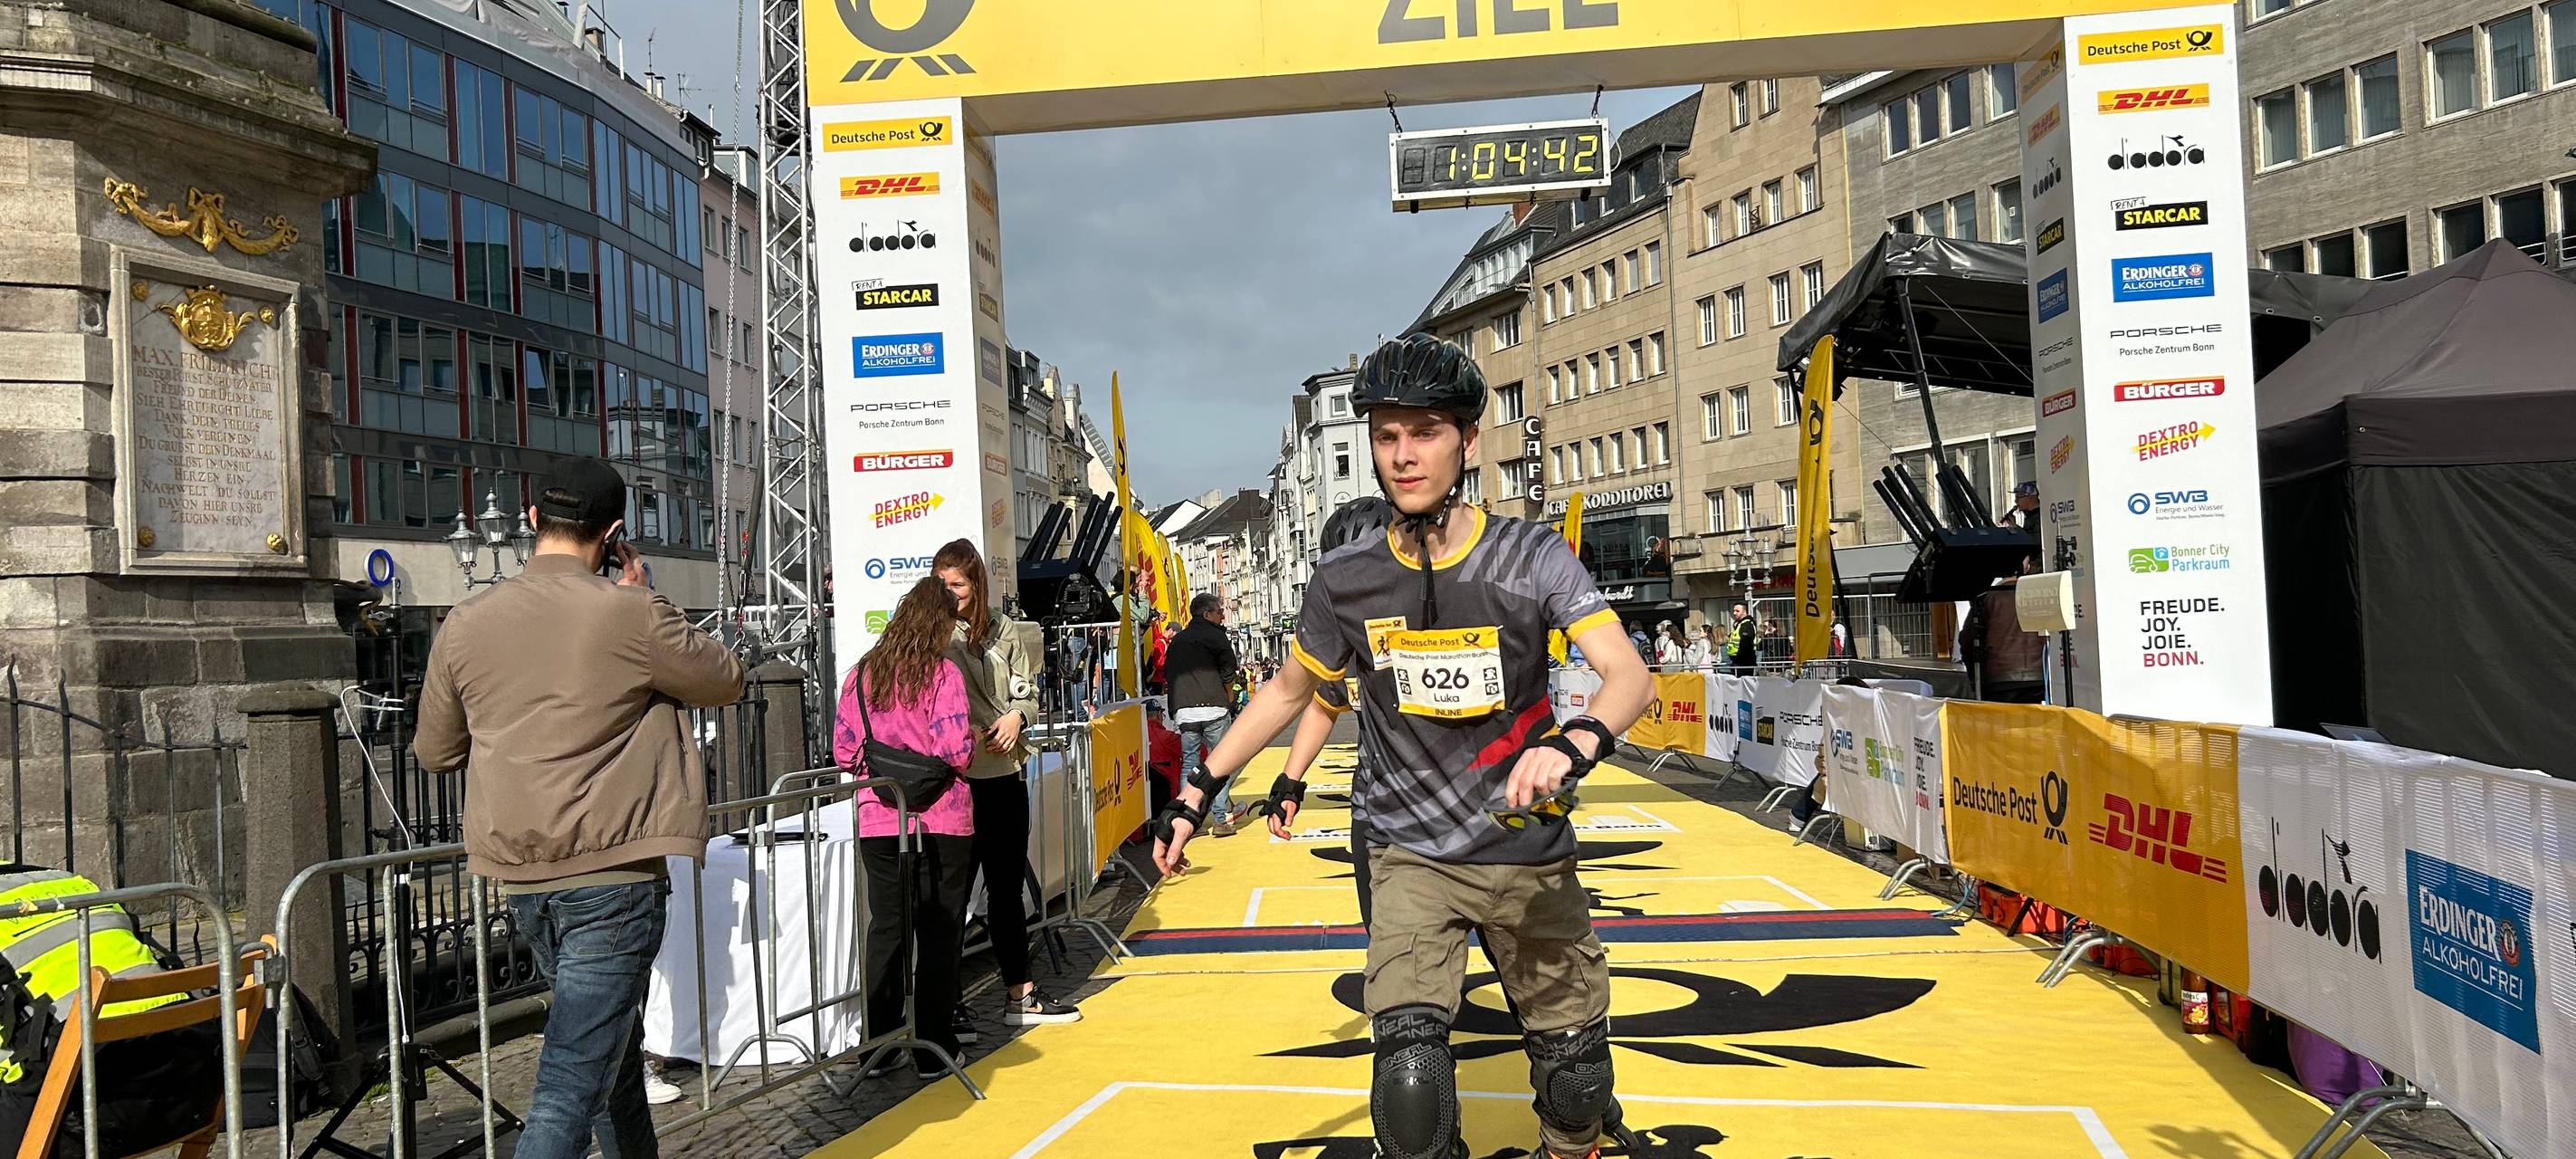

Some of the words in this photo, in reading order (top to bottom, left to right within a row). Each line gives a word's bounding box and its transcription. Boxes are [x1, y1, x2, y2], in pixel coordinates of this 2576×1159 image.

[2087, 41, 2148, 57] Deutsche
[2151, 39, 2181, 52] Post
[2113, 89, 2194, 110] DHL
[831, 131, 886, 145] Deutsche
[889, 129, 915, 140] Post
[1448, 135, 1598, 181] 1:04:42
[2107, 135, 2205, 170] diadora
[854, 177, 928, 196] DHL
[2123, 206, 2201, 225] STARCAR
[849, 220, 936, 253] diadora
[2122, 264, 2188, 281] ERDINGER
[2123, 279, 2205, 290] ALKOHOLFREI
[863, 289, 932, 305] STARCAR
[2110, 324, 2222, 339] PORSCHE
[862, 344, 921, 357] ERDINGER
[2119, 346, 2153, 356] Porsche
[2154, 344, 2190, 354] Zentrum
[2193, 342, 2215, 351] Bonn
[862, 356, 936, 367] ALKOHOLFREI
[199, 388, 217, 399] DER
[2123, 382, 2215, 399] BÜRGER
[851, 399, 950, 412] PORSCHE
[859, 420, 890, 429] Porsche
[891, 418, 923, 427] Zentrum
[925, 417, 945, 426] Bonn
[2138, 421, 2199, 447] DEXTRO
[139, 436, 155, 449] DU
[2139, 435, 2199, 461] ENERGY
[862, 454, 945, 470] BÜRGER
[1525, 418, 1542, 501] CAFE
[227, 474, 246, 484] EIN
[142, 479, 207, 497] NACHWELT
[218, 487, 233, 498] DU
[238, 489, 277, 501] SOLLST
[2155, 490, 2208, 504] SWB
[204, 500, 226, 512] HIER
[875, 491, 930, 515] DEXTRO
[1549, 499, 1570, 515] CAF
[1583, 483, 1669, 510] KONDITOREI
[875, 503, 930, 529] ENERGY
[2155, 506, 2181, 514] Energie
[2171, 546, 2207, 557] Bonner
[2209, 544, 2229, 557] City
[2172, 559, 2229, 571] Parkraum
[2140, 598, 2226, 616] FREUDE.
[2141, 617, 2181, 633] JOY.
[1401, 637, 1437, 647] Deutsche
[2142, 634, 2191, 650] JOIE.
[1399, 652, 1424, 660] Deutsche
[2143, 651, 2205, 667] BONN.
[1421, 667, 1470, 690] 626
[1434, 693, 1460, 703] Luka
[1435, 708, 1463, 716] INLINE
[1671, 701, 1699, 722] DHL
[1953, 776, 2007, 817] Deutsche
[2009, 787, 2037, 825] Post
[2102, 793, 2206, 875] DHL
[2258, 816, 2382, 965] diadora
[2419, 885, 2502, 962] ERDINGER
[2423, 937, 2524, 1001] ALKOHOLFREI
